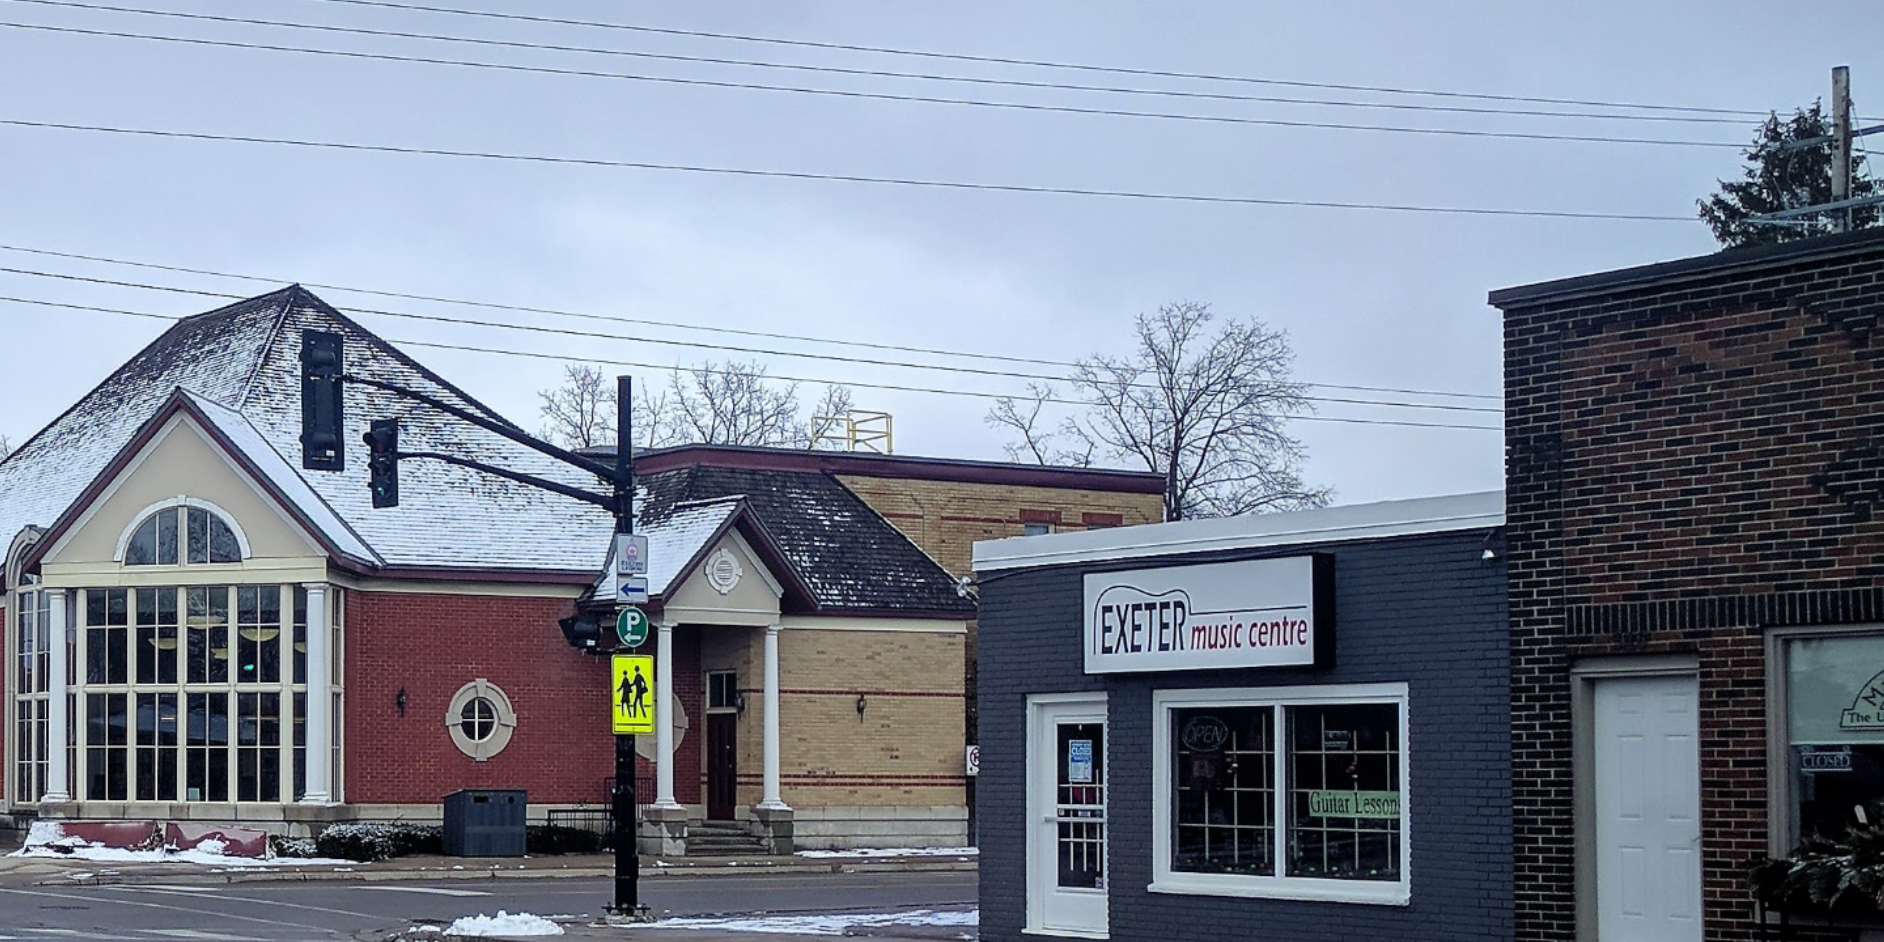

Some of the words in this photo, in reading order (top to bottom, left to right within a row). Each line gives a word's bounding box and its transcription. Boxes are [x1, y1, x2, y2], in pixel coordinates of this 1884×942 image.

[626, 611, 641, 631] P
[1101, 600, 1186, 655] EXETER
[1190, 616, 1242, 651] music
[1249, 615, 1308, 647] centre
[1848, 712, 1871, 723] The
[1185, 725, 1224, 744] OPEN
[1802, 755, 1850, 767] CLOSED
[1310, 791, 1351, 814] Guitar
[1354, 791, 1400, 815] Lesson
